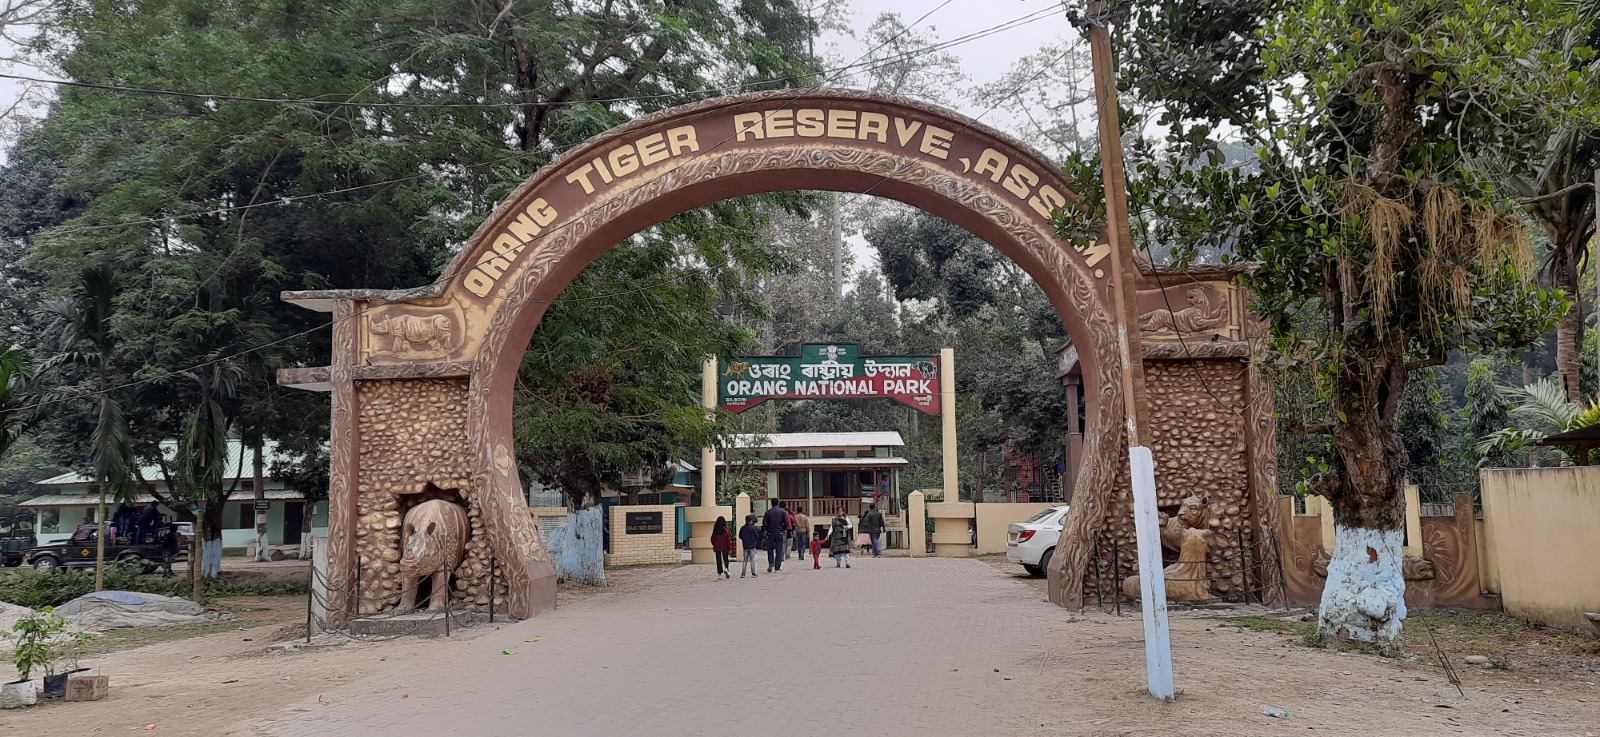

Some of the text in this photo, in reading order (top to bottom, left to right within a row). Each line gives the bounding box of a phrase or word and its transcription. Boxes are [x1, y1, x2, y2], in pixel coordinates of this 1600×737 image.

[463, 197, 558, 298] ORANG
[565, 125, 700, 195] TIGER
[864, 359, 912, 378] উদ্যান
[727, 379, 933, 396] ORANG NATIONAL PARK
